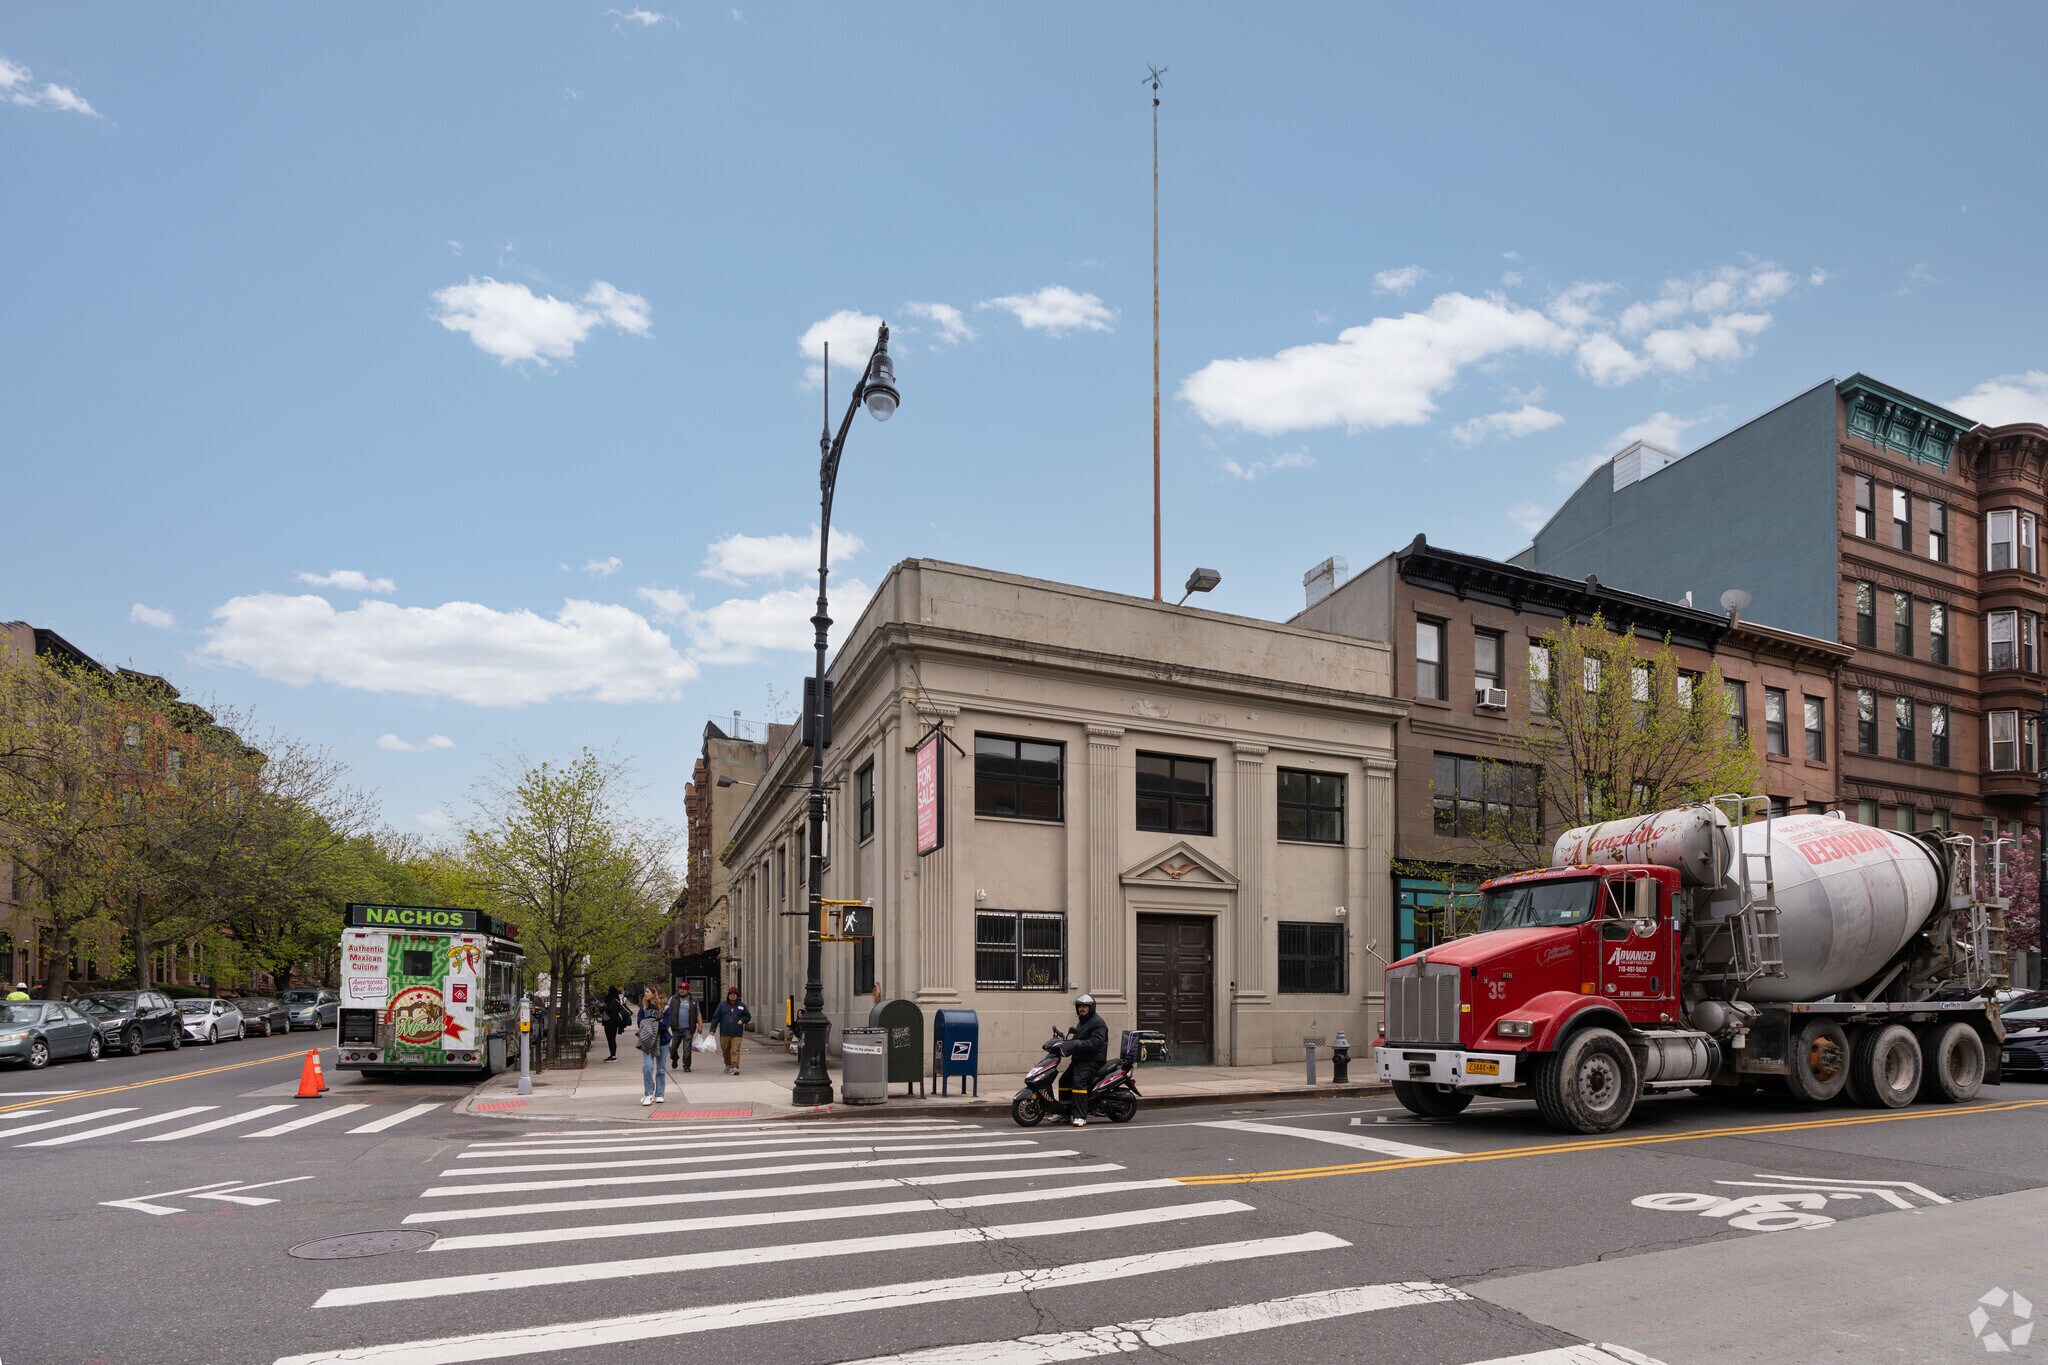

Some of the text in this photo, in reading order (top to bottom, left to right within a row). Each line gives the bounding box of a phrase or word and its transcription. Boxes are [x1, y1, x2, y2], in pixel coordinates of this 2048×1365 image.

[917, 765, 932, 789] FOR
[917, 783, 935, 810] SALE
[366, 908, 463, 926] NACHOS
[348, 945, 384, 953] Authentic
[349, 954, 382, 962] Mexican
[1607, 947, 1656, 966] ADVANCED
[352, 963, 379, 971] Cuisine
[1488, 981, 1507, 1000] 35
